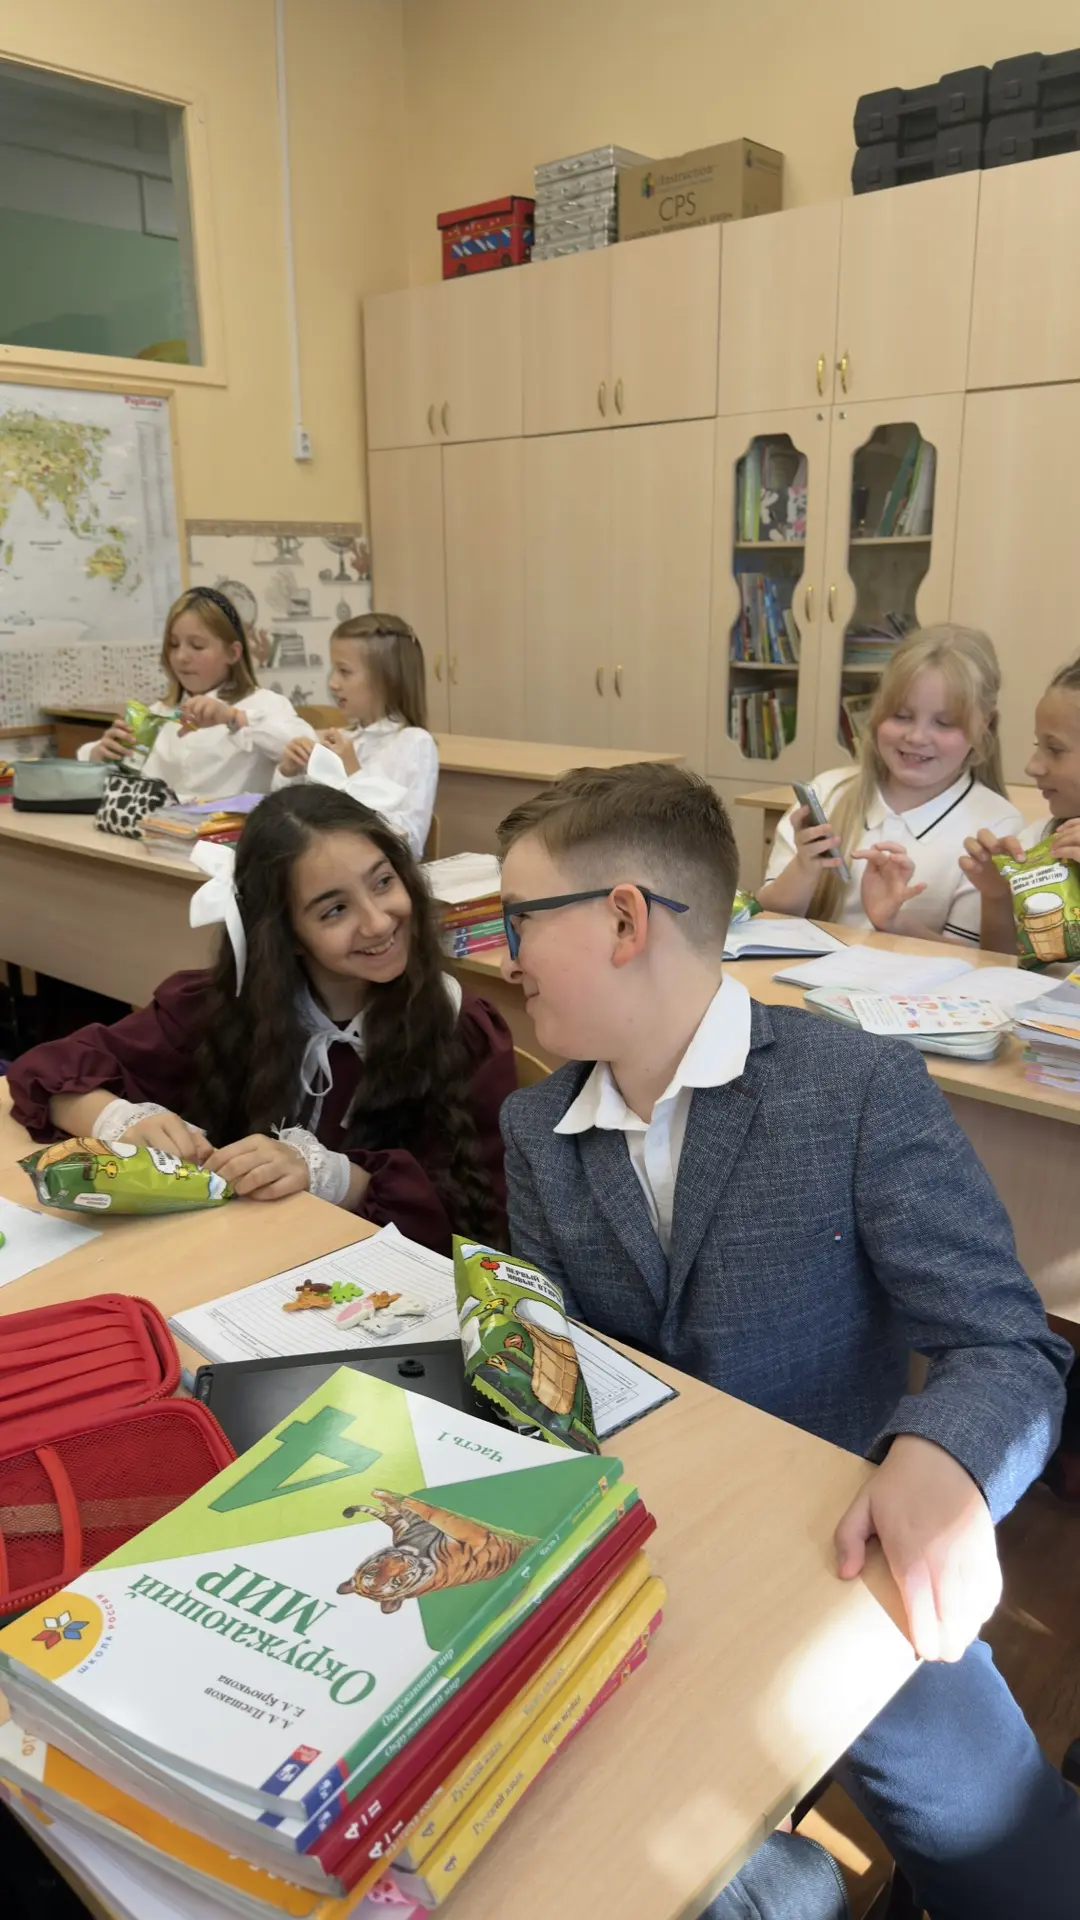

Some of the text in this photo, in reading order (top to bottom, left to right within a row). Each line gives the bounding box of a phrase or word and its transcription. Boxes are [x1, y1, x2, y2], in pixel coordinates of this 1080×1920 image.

[658, 190, 697, 221] CPS
[505, 1266, 540, 1283] ПЕРВЫЙ
[507, 1273, 534, 1288] НОВЫЕ
[208, 1405, 383, 1513] 4
[436, 1430, 503, 1463] Часть 1
[195, 1563, 338, 1636] МИР
[77, 1593, 117, 1675] ШКОЛА РОССИИ
[124, 1574, 376, 1705] Окружающий
[203, 1686, 295, 1730] А. А. Плешаков
[217, 1674, 281, 1707] Крючкова
[280, 1700, 293, 1713] А.
[381, 1648, 454, 1727] Окружающий мир
[384, 1677, 460, 1757] Окружающий мир
[472, 1793, 505, 1836] Русский
